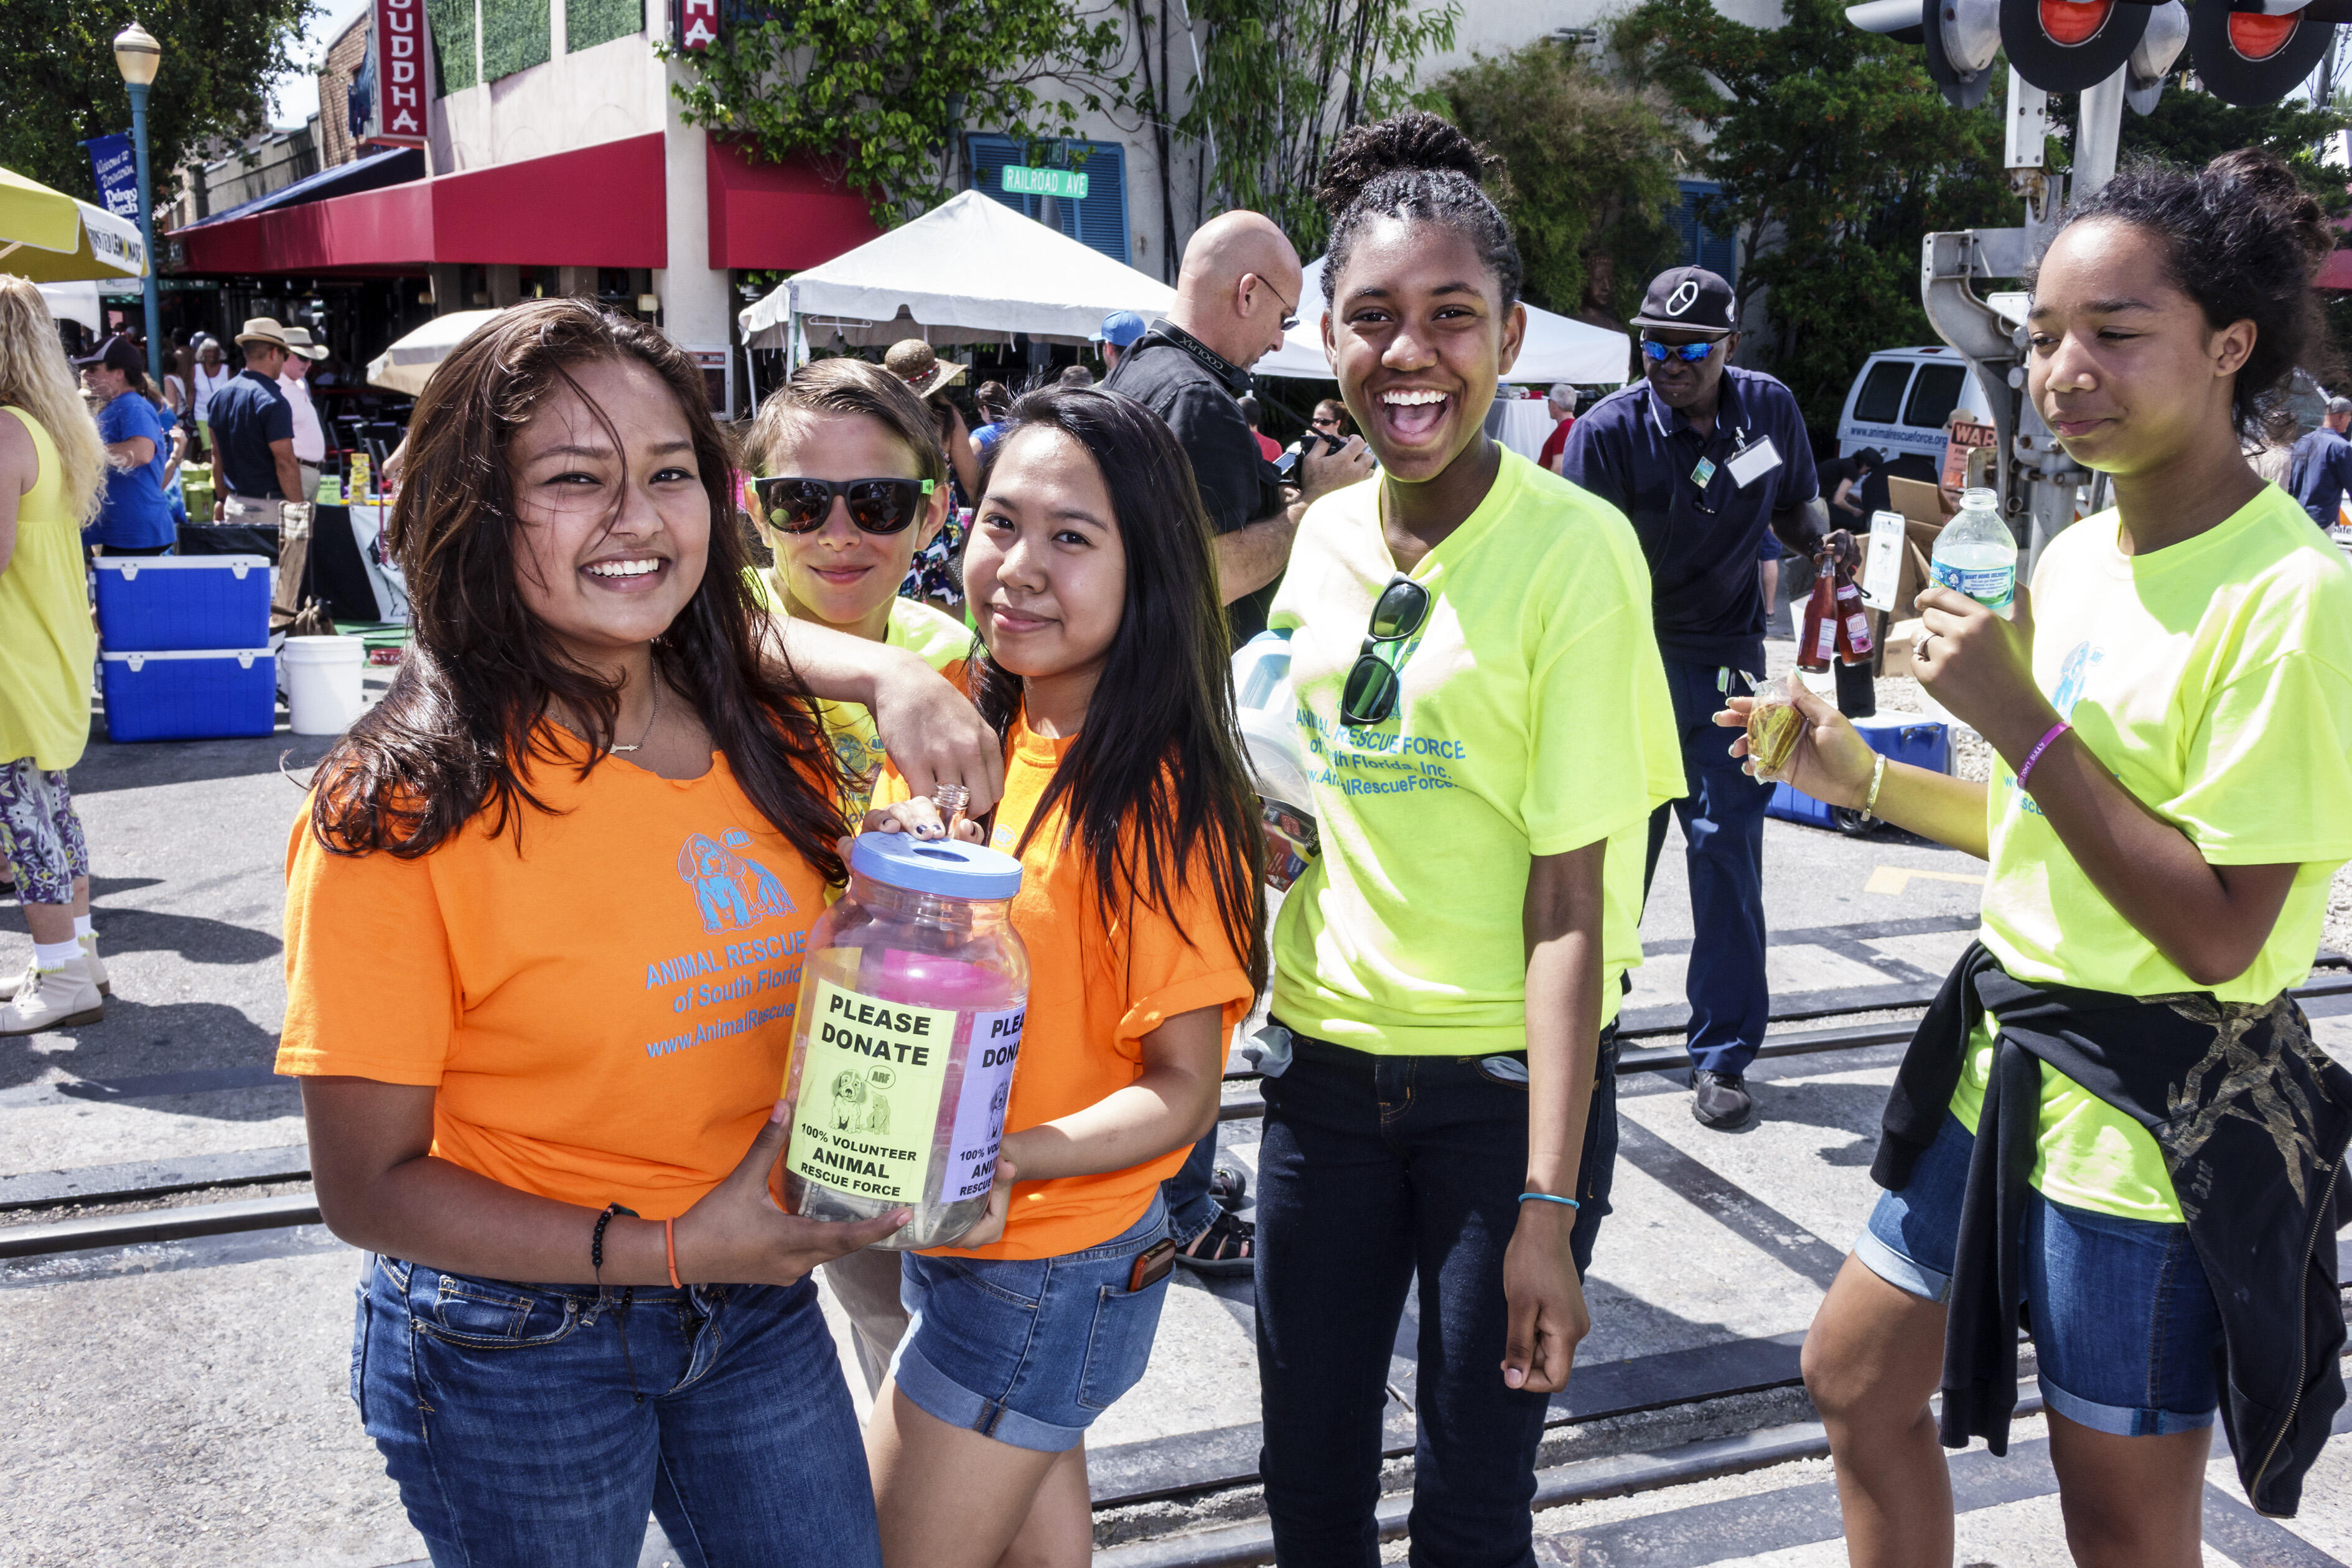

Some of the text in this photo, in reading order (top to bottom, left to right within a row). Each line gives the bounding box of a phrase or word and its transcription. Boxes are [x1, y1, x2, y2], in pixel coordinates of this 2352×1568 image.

[105, 187, 138, 204] Delray
[1006, 168, 1086, 195] RAILROAD AVE
[1179, 337, 1223, 370] COOLPIX
[1850, 426, 1948, 449] www.animalrescueforce.org
[1333, 724, 1400, 754] RESCUE
[1403, 736, 1467, 760] FORCE
[2029, 742, 2045, 762] BULLY
[1419, 761, 1452, 779] Inc.
[646, 930, 806, 990] ANIMAL RESCUE
[673, 961, 803, 1013] of South Florid
[645, 1002, 795, 1058] www.AnimalRescue
[829, 994, 931, 1037] PLEASE
[821, 1022, 930, 1066] DONATE
[871, 1070, 891, 1085] ARF
[801, 1122, 917, 1162] 100% VOLUNTEER
[960, 1147, 985, 1161] 100%
[800, 1162, 901, 1197] RESCUE FORCE
[812, 1147, 890, 1179] ANIMAL
